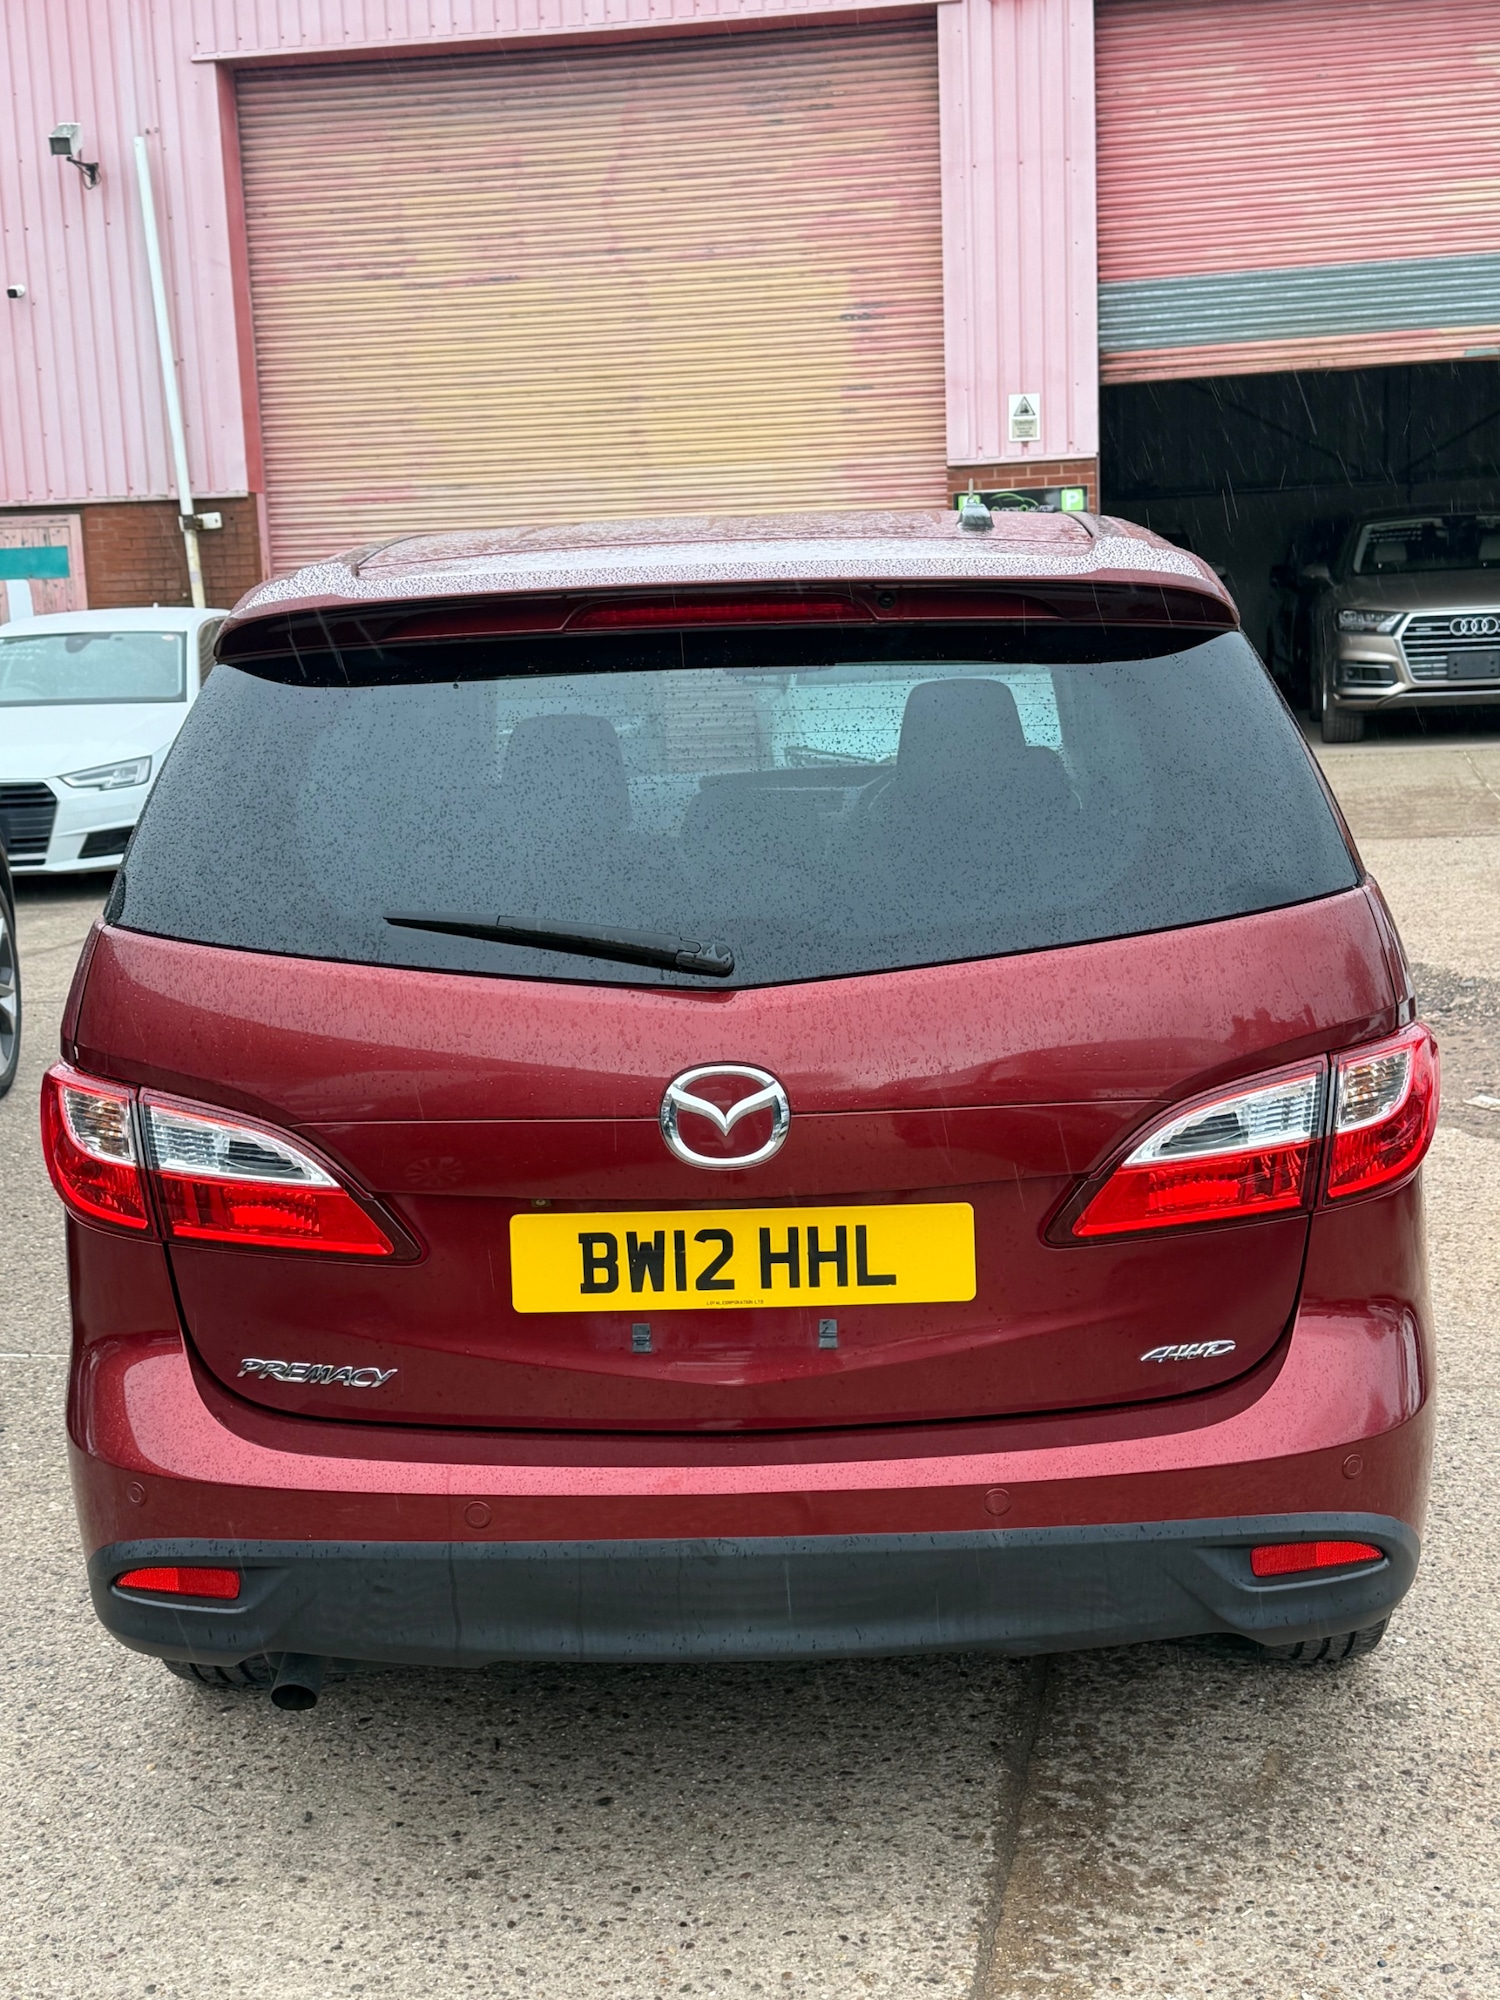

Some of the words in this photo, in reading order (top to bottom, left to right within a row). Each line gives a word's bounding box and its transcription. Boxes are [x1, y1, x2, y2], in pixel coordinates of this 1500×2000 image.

[578, 1228, 735, 1294] BW12
[759, 1225, 897, 1289] HHL
[1140, 1339, 1236, 1363] 4WD
[236, 1358, 399, 1389] PREMACY
